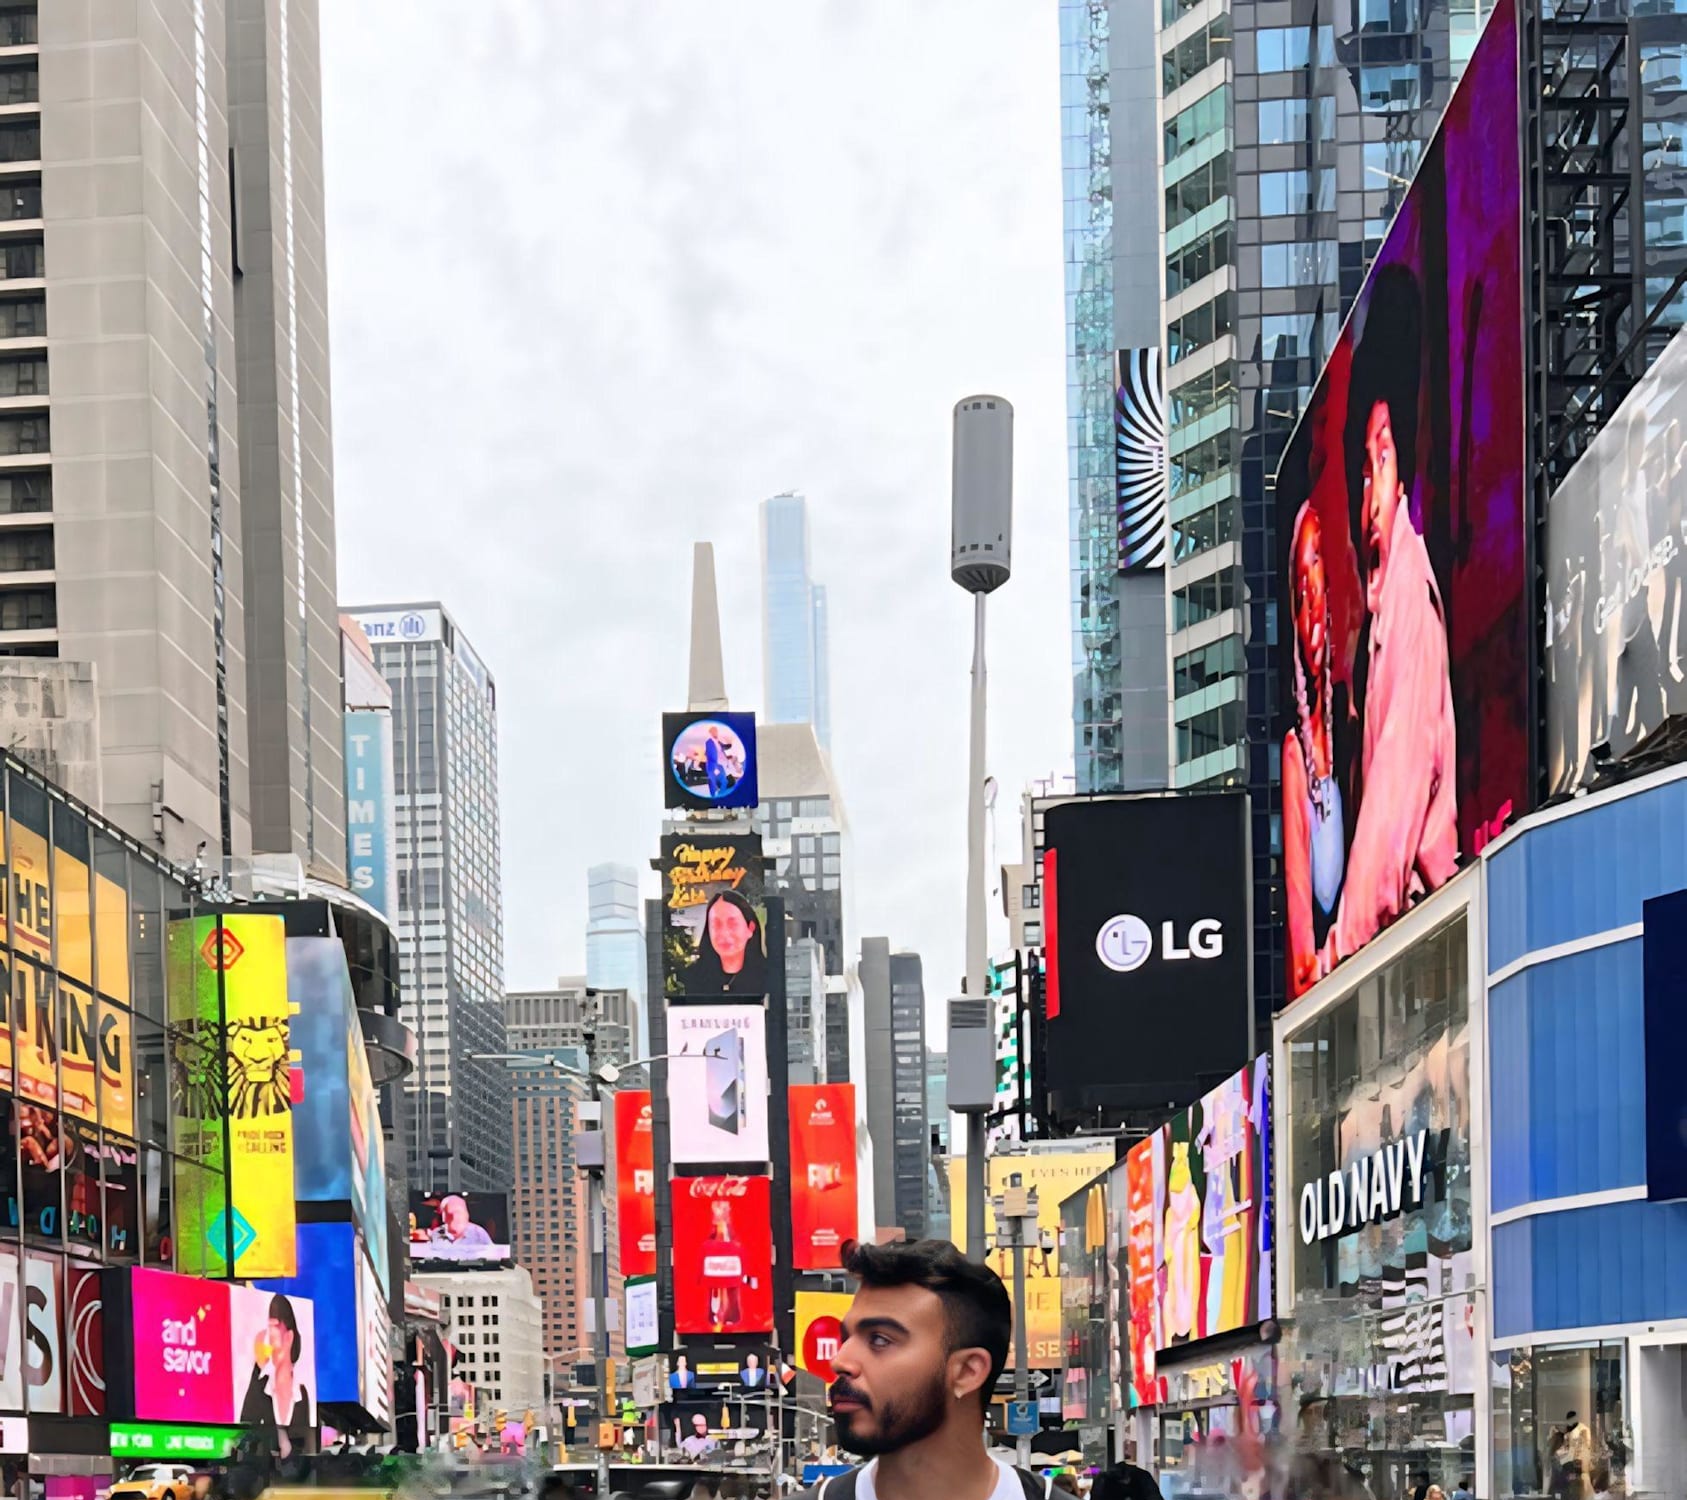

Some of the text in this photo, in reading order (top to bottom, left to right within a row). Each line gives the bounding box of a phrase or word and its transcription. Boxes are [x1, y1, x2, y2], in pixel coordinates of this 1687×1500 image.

[357, 620, 395, 637] anz
[349, 734, 375, 889] TIMES
[1161, 918, 1224, 960] LG
[32, 950, 121, 1074] KING
[1300, 1129, 1427, 1245] OLD NAVY
[161, 1315, 197, 1347] and
[162, 1346, 212, 1375] savor
